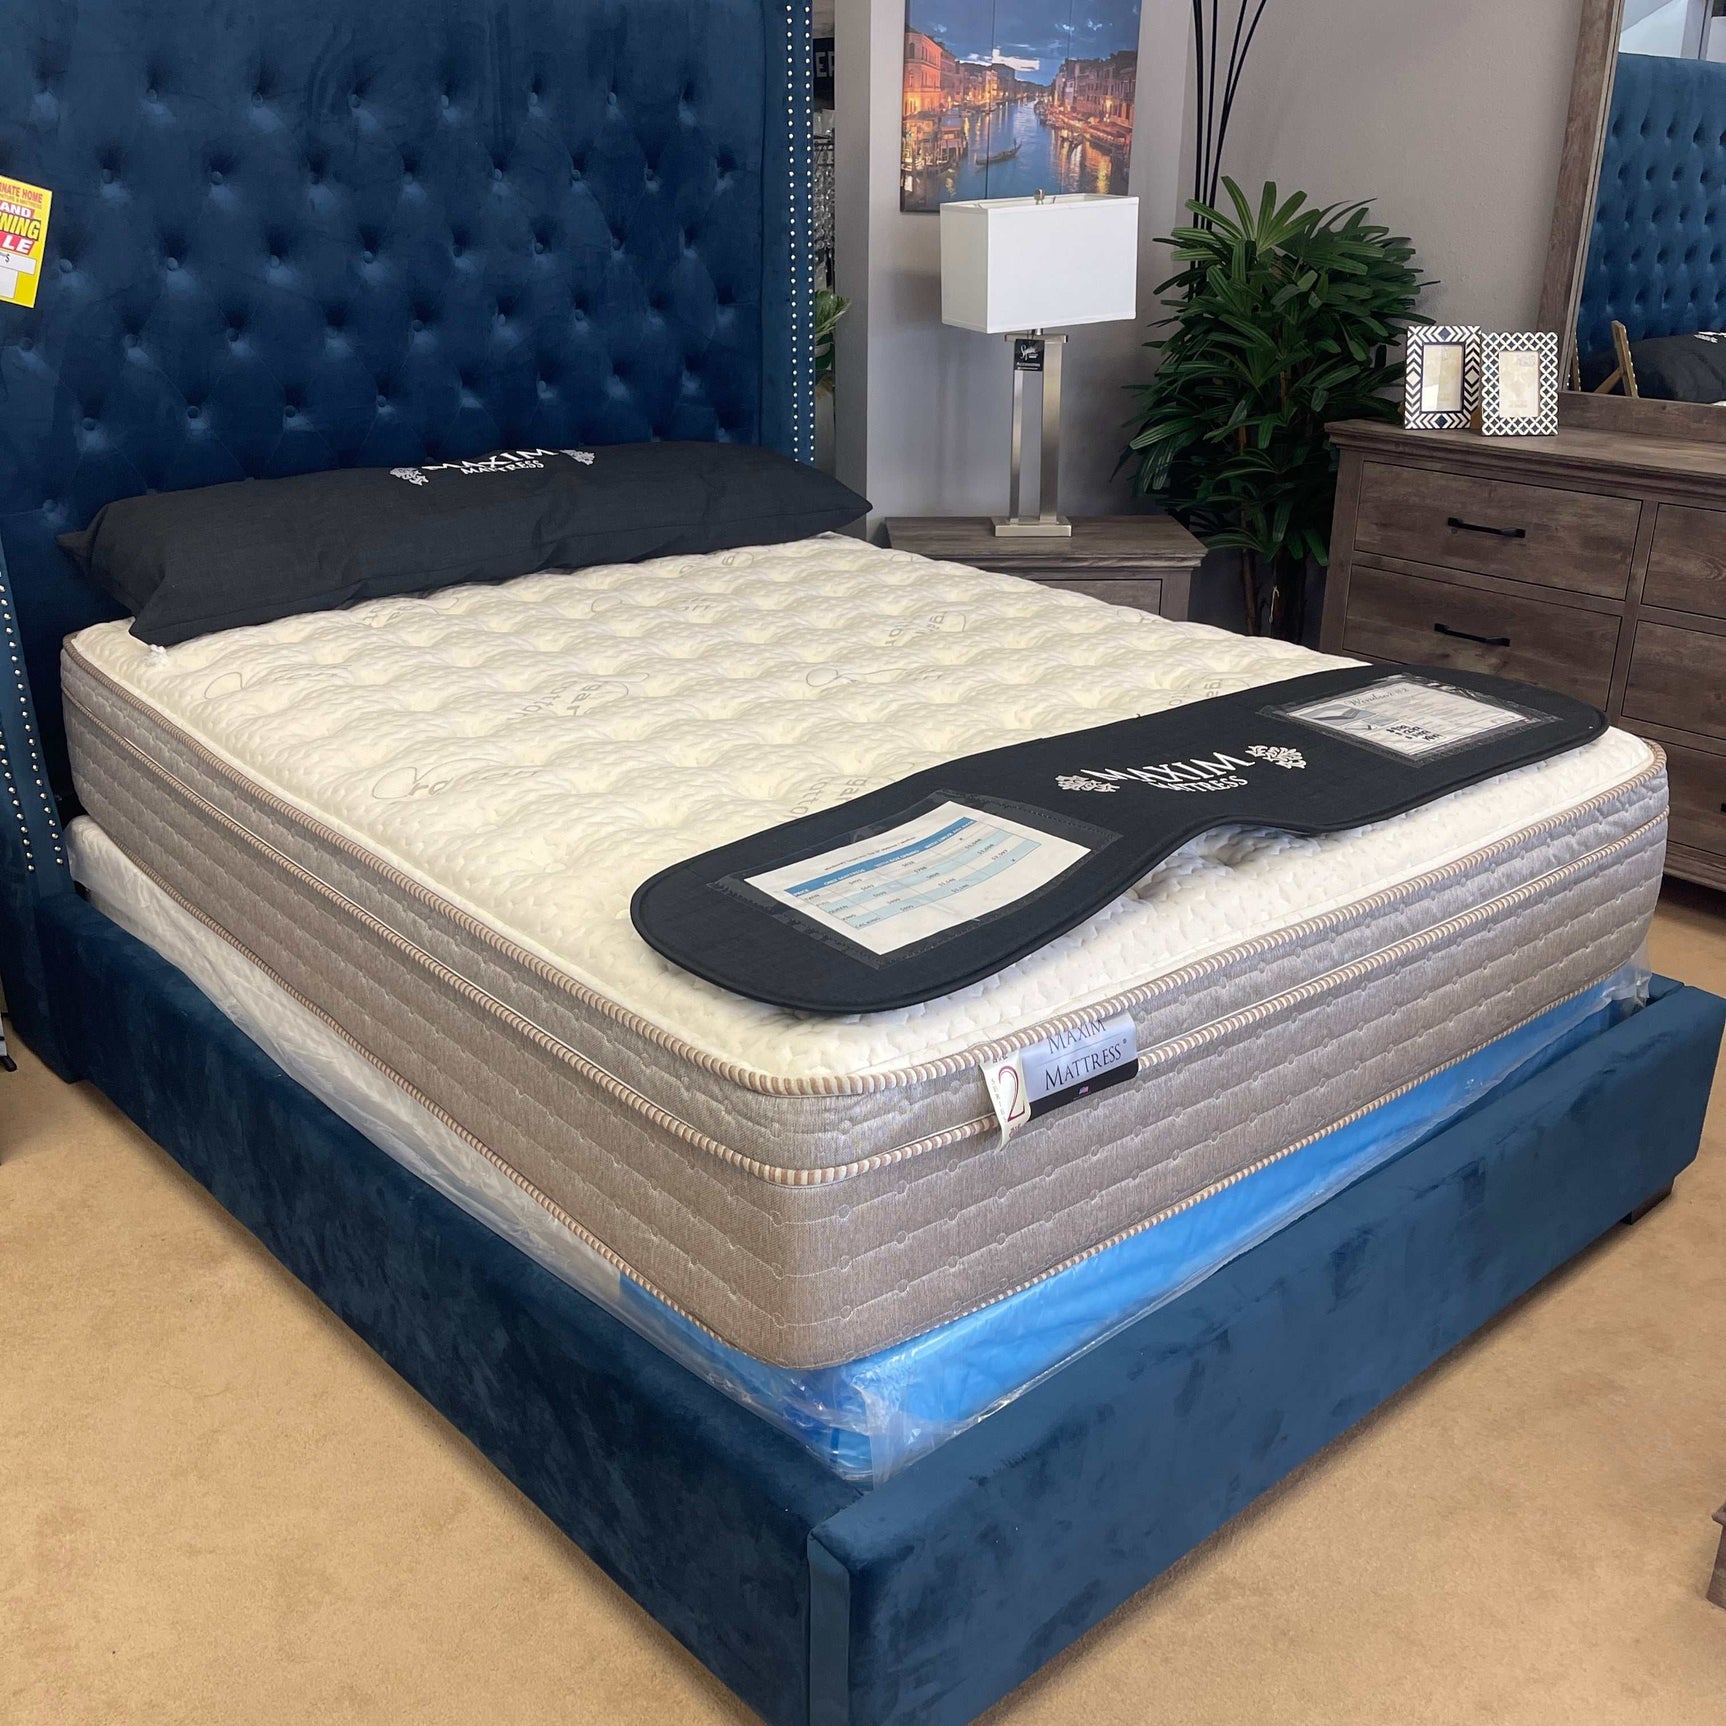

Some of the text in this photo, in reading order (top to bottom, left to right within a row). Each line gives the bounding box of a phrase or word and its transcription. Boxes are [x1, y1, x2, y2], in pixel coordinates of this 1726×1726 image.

[0, 202, 32, 218] AND
[22, 188, 43, 203] HOME
[0, 211, 41, 241] NING
[421, 448, 559, 471] MAXIM
[1080, 752, 1256, 783] MAXIM
[1049, 1018, 1107, 1054] MAXIM
[1044, 1043, 1122, 1091] MATTRESS
[997, 1065, 1026, 1122] 2
